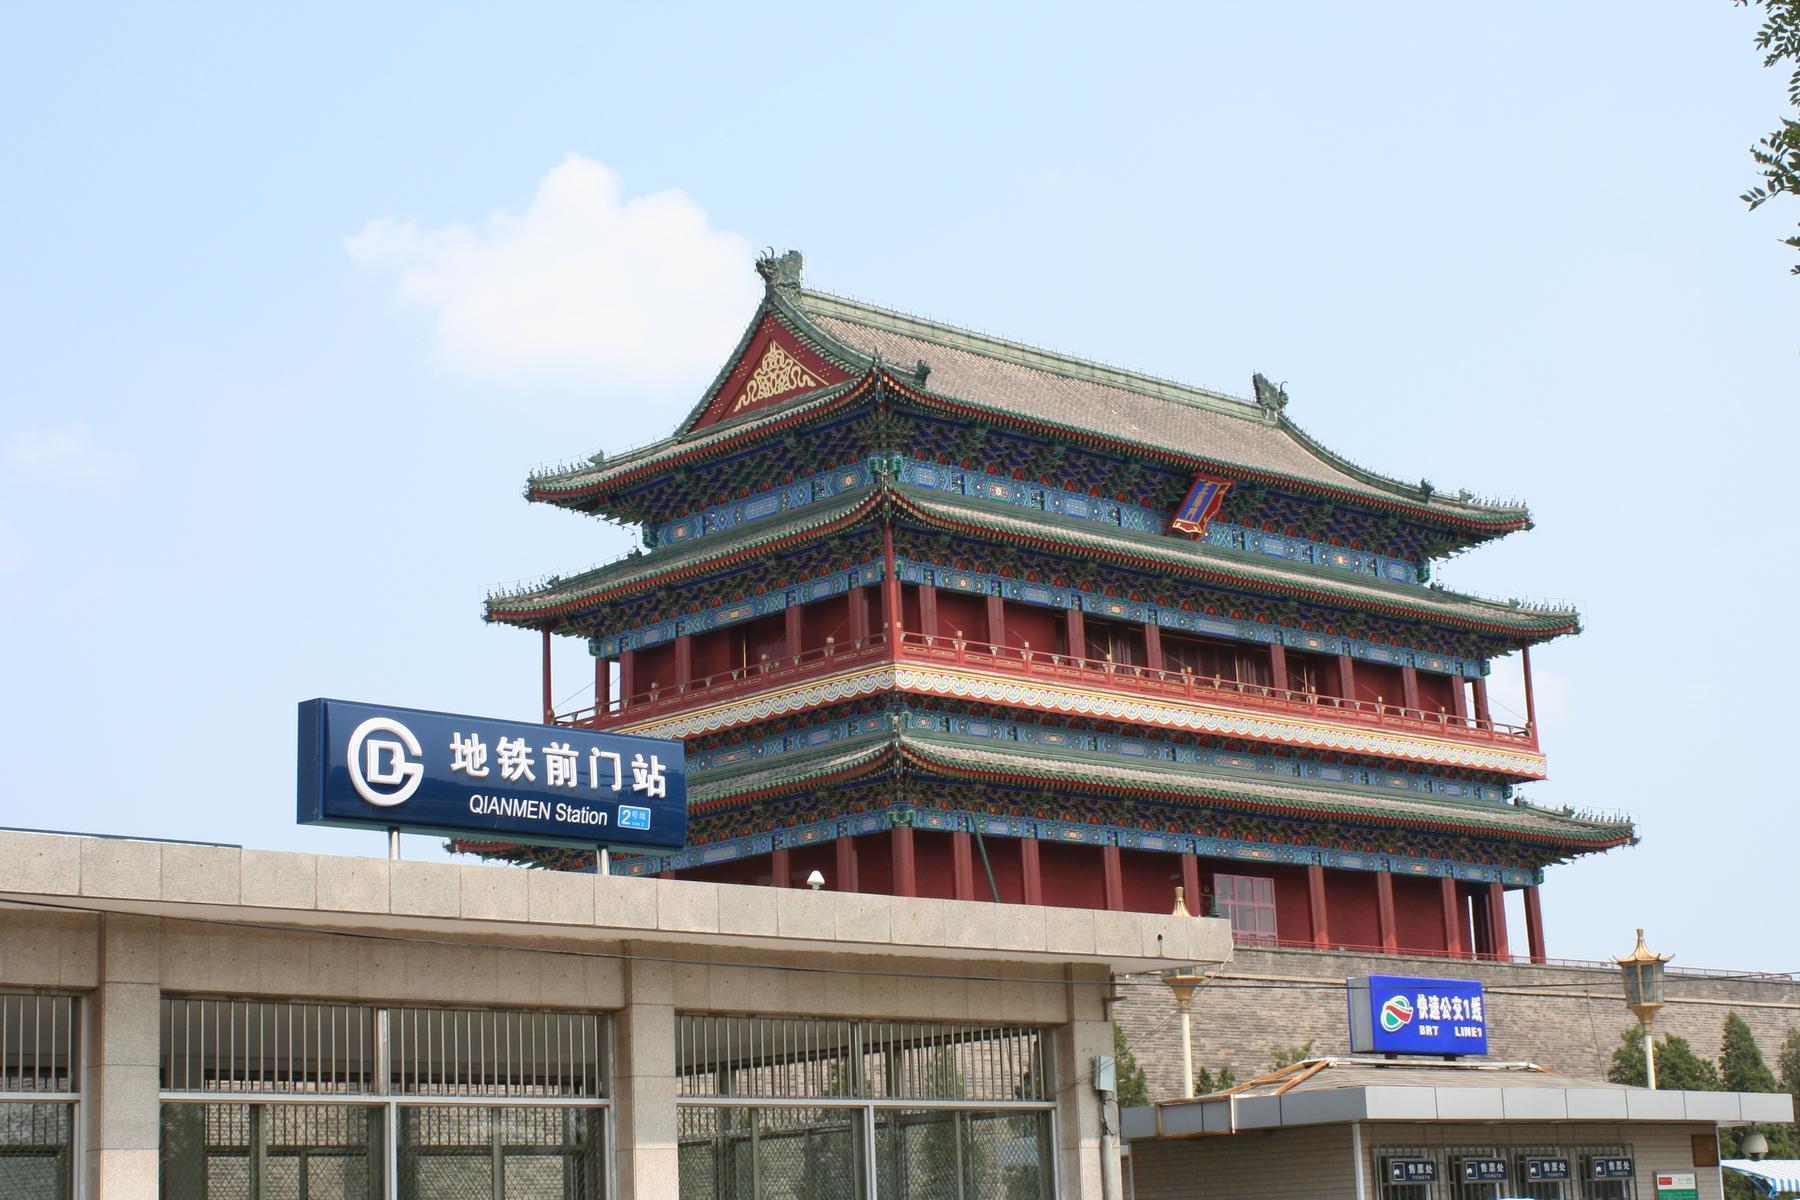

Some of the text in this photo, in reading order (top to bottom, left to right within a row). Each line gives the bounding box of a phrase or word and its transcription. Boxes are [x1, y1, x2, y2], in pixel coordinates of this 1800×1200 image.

[449, 731, 666, 798] 地铁前门站
[469, 794, 608, 826] QIANMEN Station
[1417, 993, 1483, 1022] 快速公交1线
[1419, 1025, 1483, 1038] BRT LINE1
[1408, 1163, 1433, 1174] 售票处
[1480, 1162, 1504, 1173] 售票处
[1543, 1161, 1566, 1172] 售票处
[1608, 1160, 1630, 1171] 售票处
